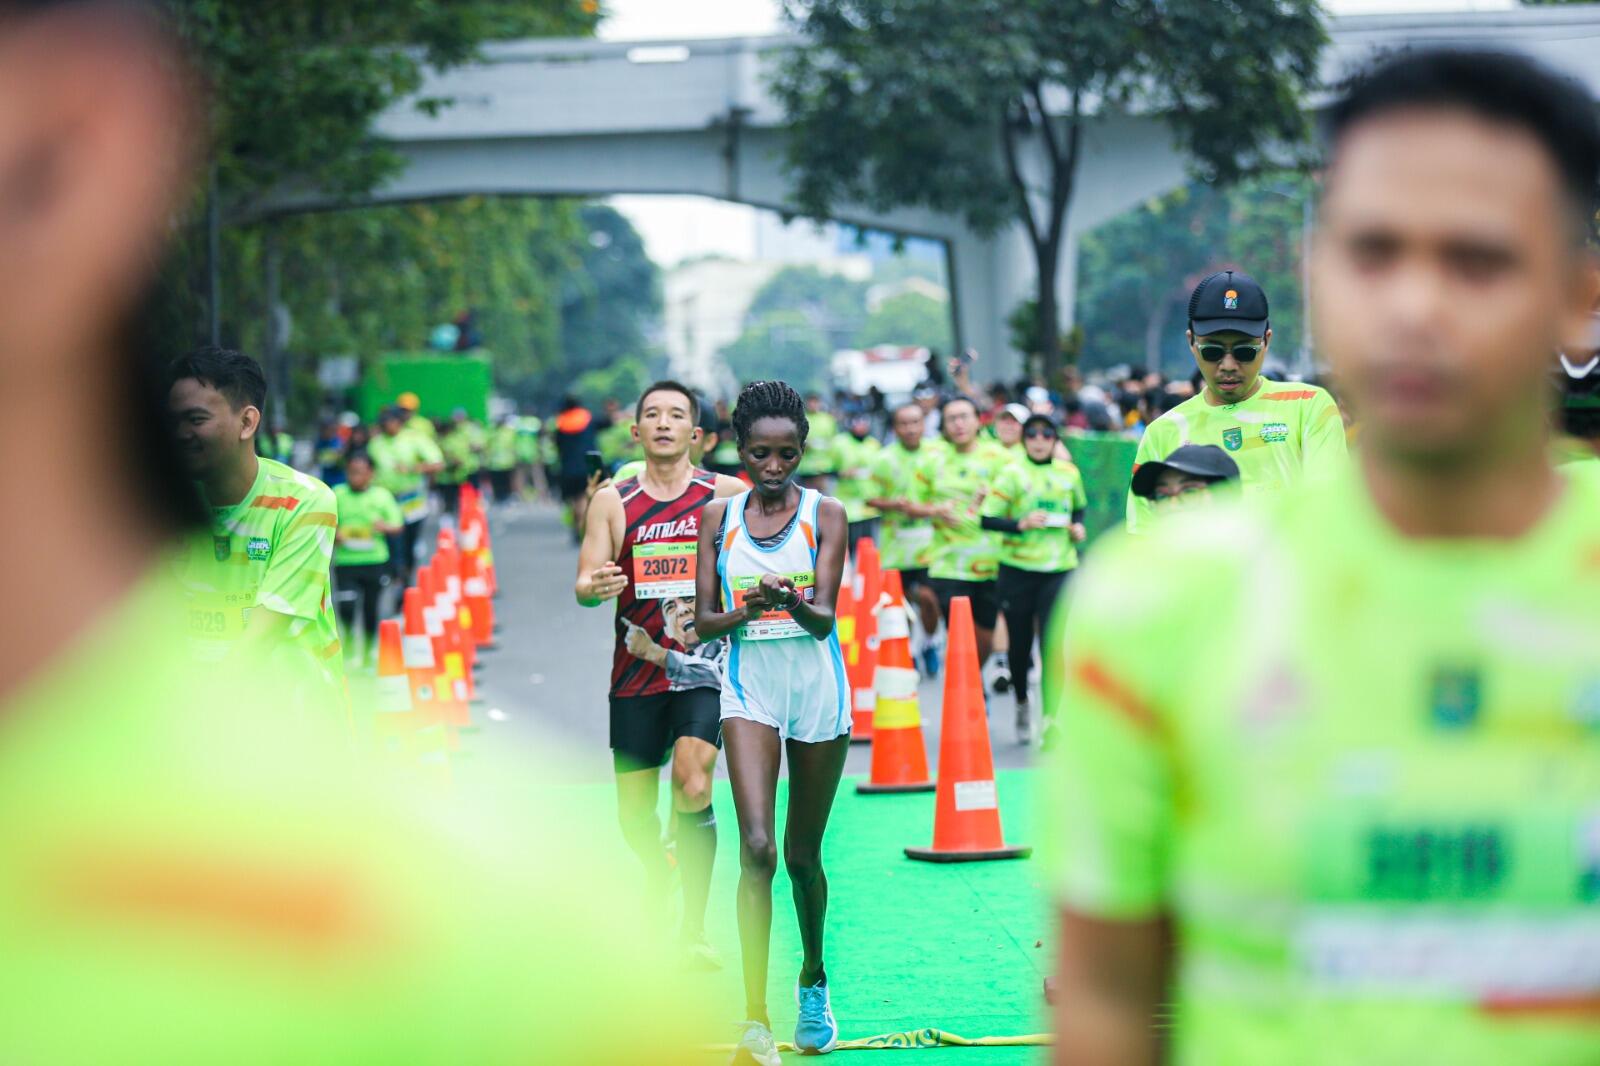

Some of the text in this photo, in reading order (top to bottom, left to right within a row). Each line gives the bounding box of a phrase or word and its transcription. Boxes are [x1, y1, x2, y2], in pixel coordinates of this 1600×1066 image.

[636, 520, 686, 542] PATRIA
[643, 558, 688, 576] 23072
[793, 574, 809, 583] F39
